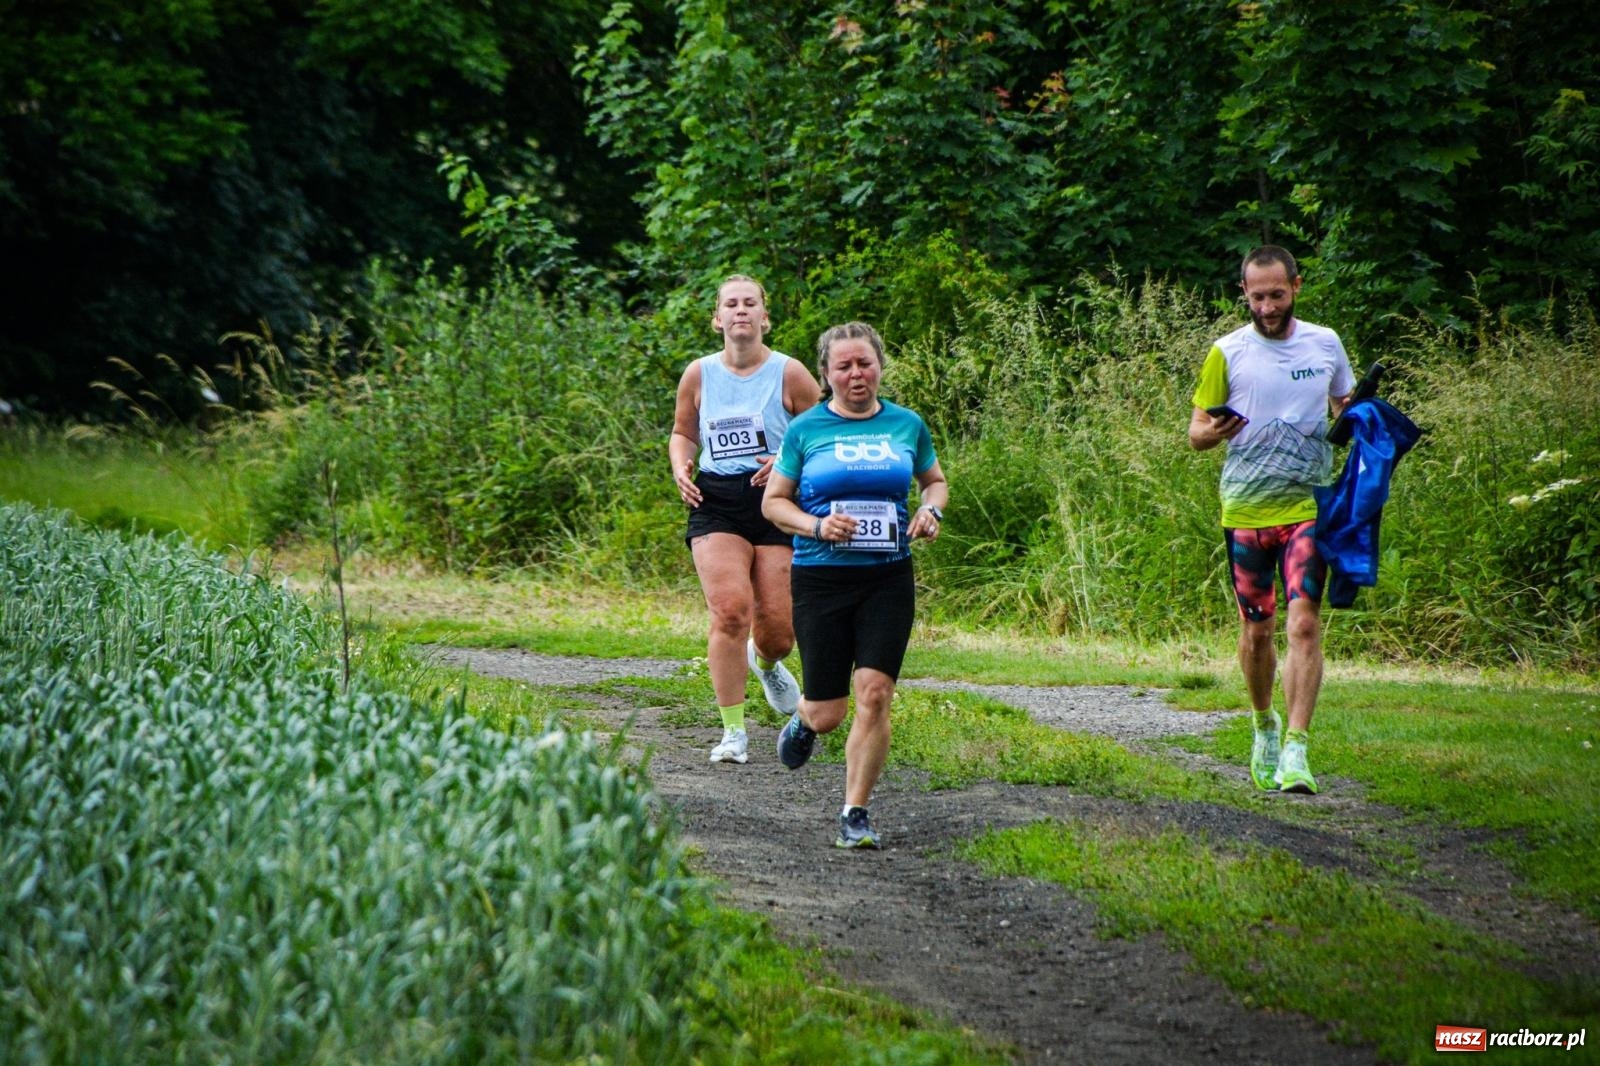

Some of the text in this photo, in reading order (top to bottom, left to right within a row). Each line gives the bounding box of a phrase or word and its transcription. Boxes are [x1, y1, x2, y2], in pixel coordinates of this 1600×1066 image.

[1291, 367, 1316, 381] UTA
[717, 430, 751, 447] 003
[859, 519, 882, 536] 38
